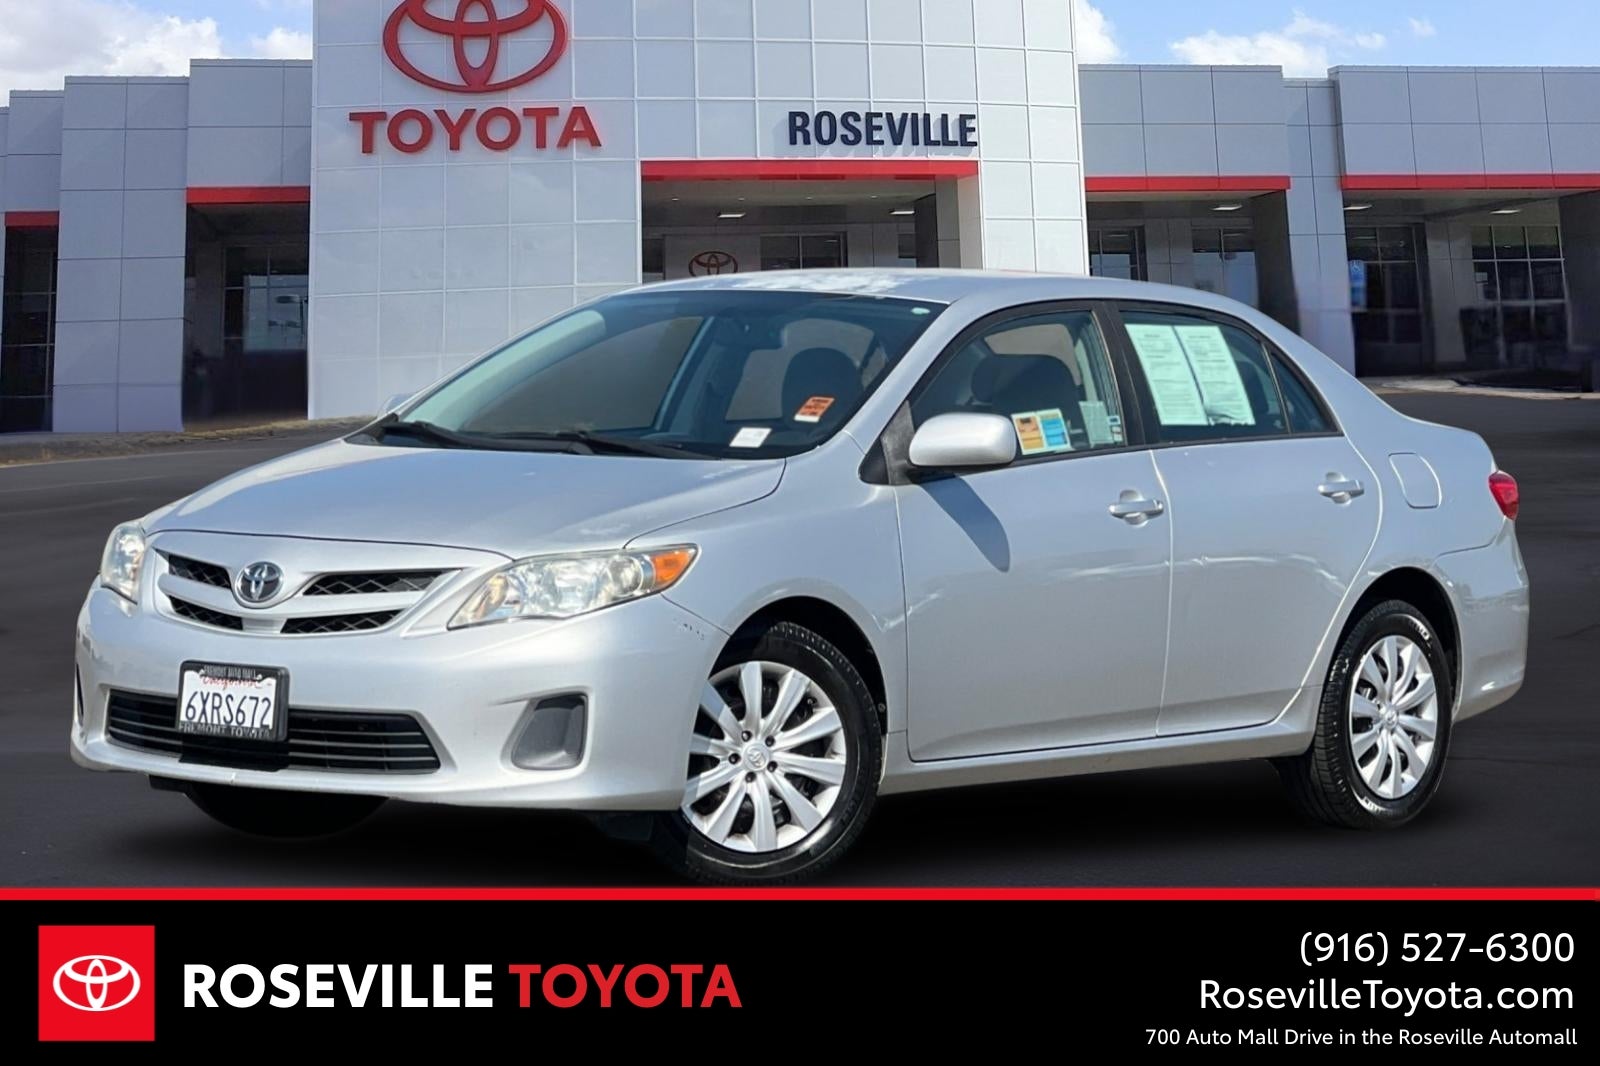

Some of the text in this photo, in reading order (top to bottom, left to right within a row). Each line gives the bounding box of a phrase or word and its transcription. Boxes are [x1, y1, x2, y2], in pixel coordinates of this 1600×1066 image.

[349, 106, 602, 154] TOYOTA
[788, 110, 978, 147] ROSEVILLE
[185, 691, 272, 729] 6XRS672
[179, 723, 271, 739] FREMONT TOYOTA
